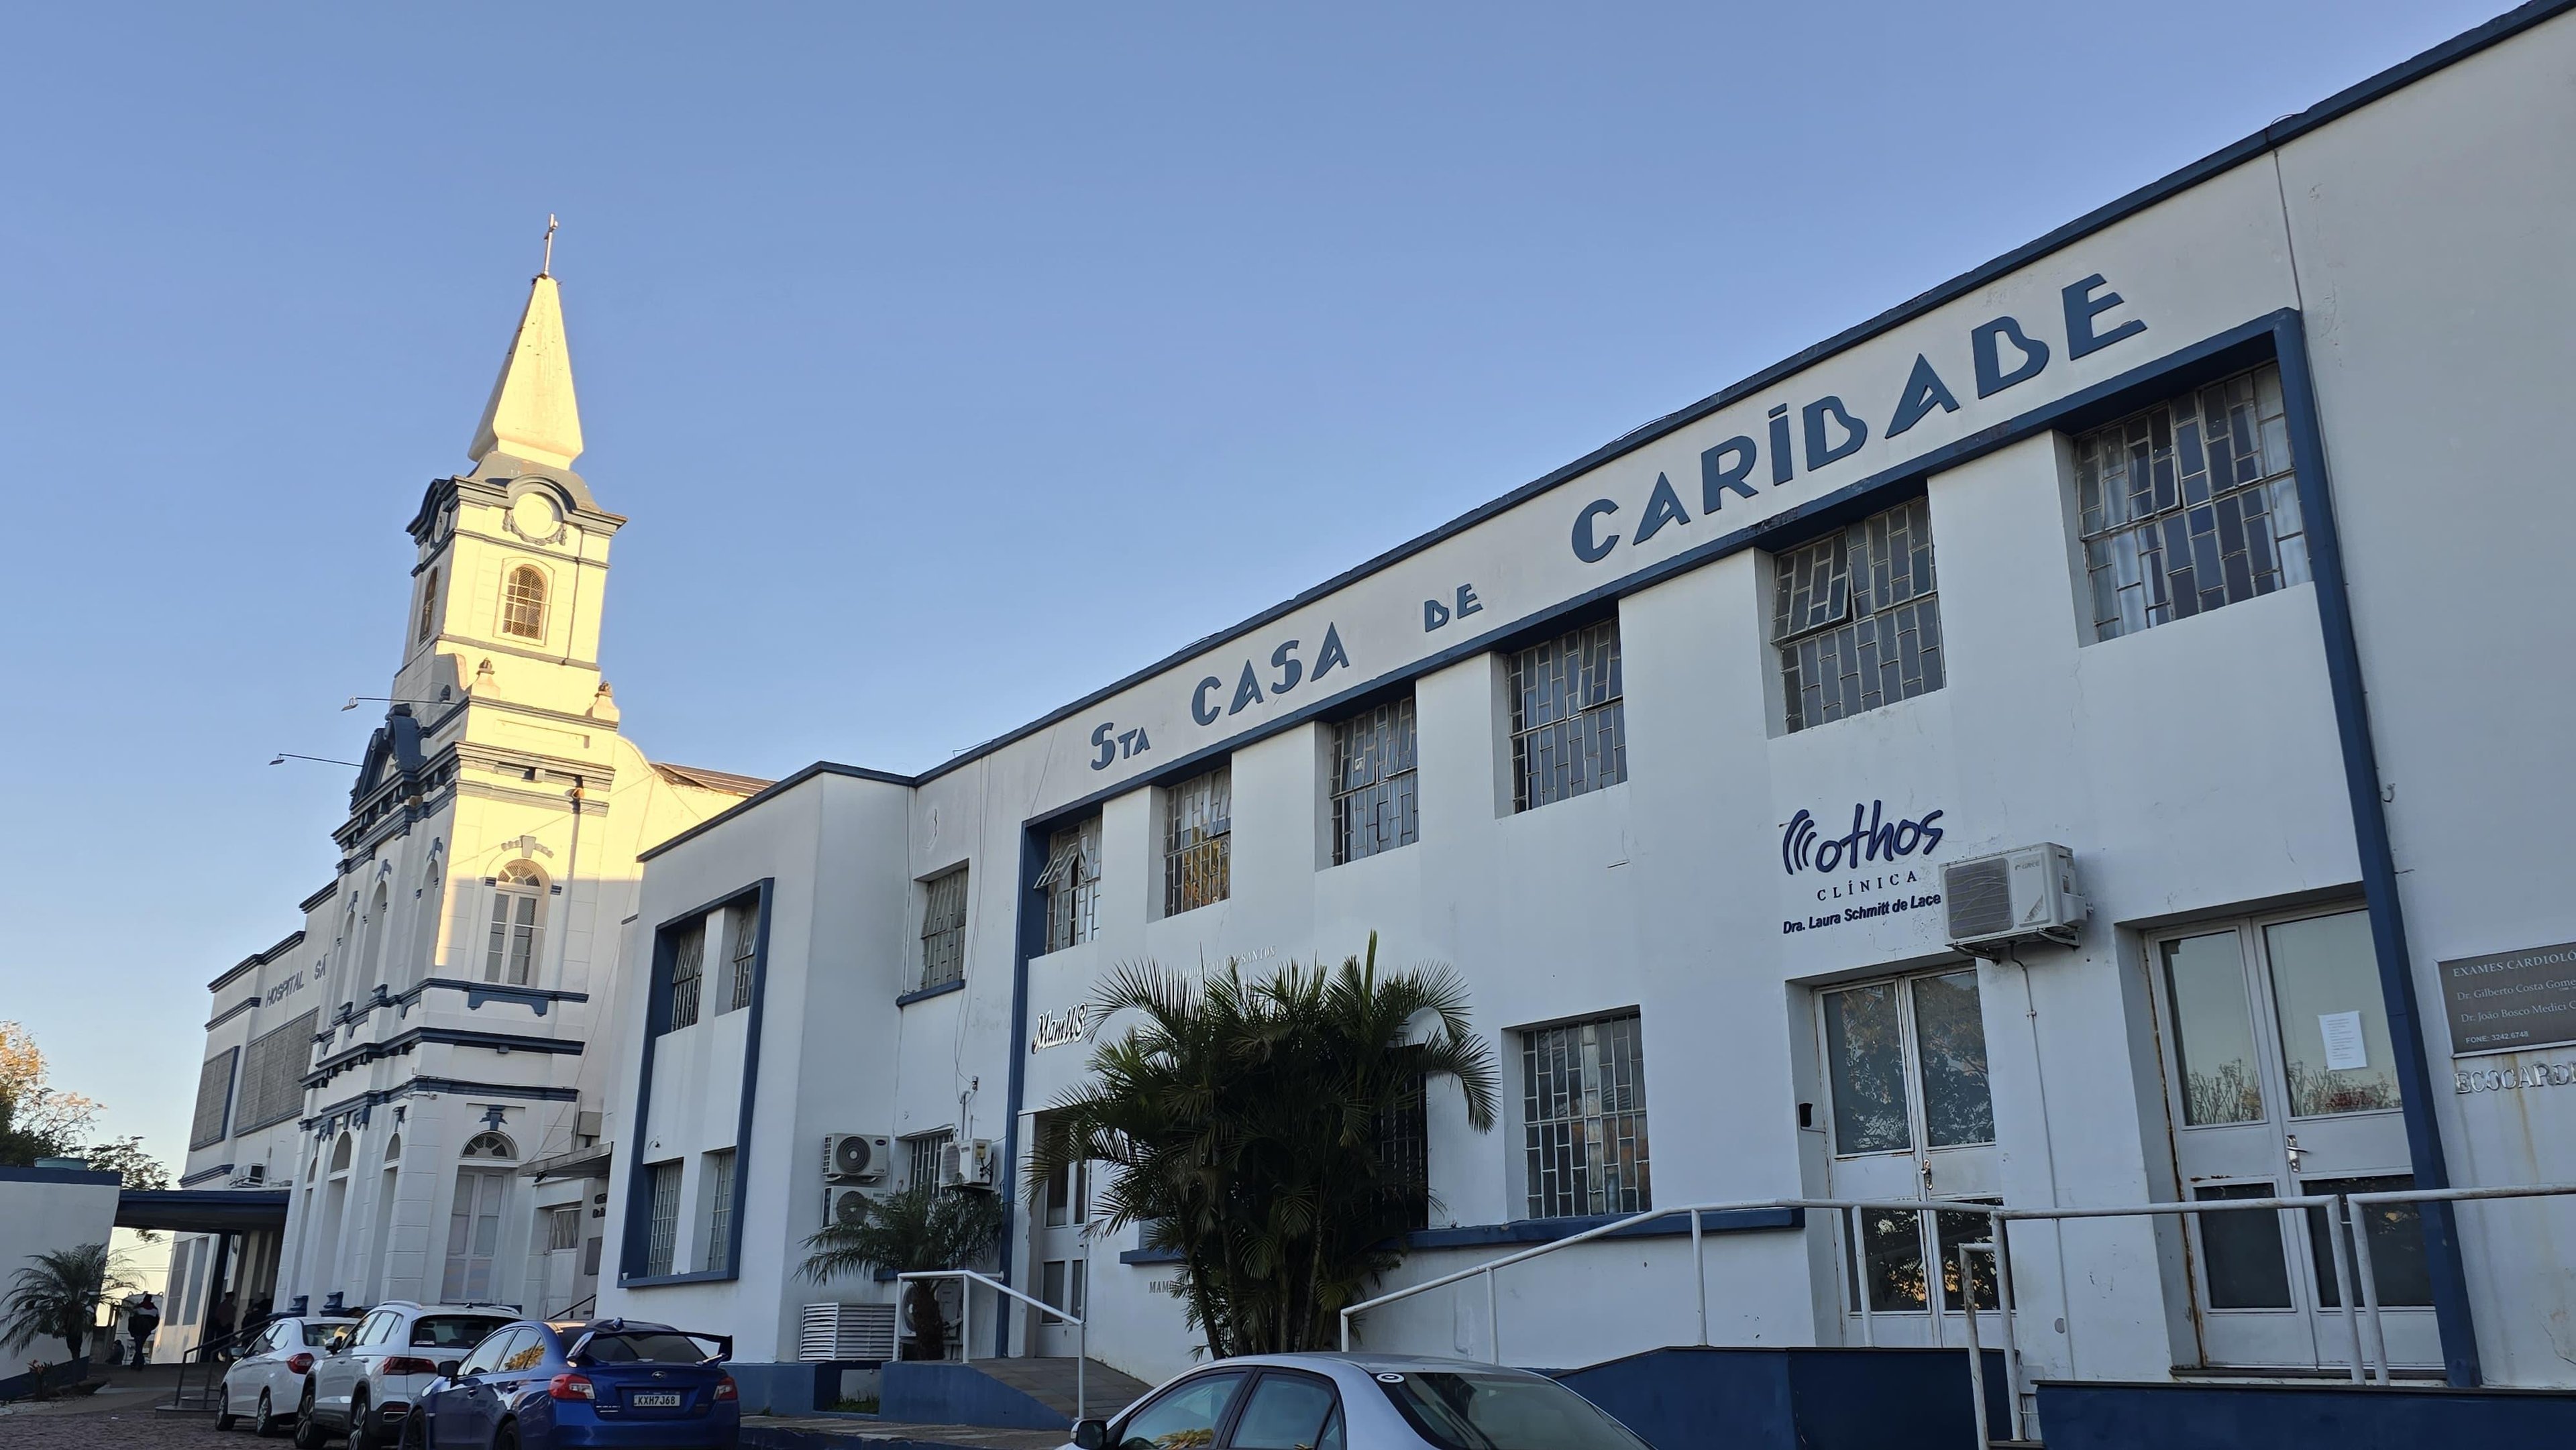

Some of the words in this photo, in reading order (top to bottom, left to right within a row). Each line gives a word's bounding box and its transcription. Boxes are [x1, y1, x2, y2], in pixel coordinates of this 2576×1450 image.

[1191, 621, 1349, 726] CASA
[1424, 583, 1483, 632] DE
[1817, 871, 1917, 901] CLÍNICA
[1782, 921, 1806, 934] Dra.
[1809, 913, 1841, 930] Laura
[1844, 901, 1890, 922] Schmitt
[1892, 899, 1908, 913] de
[1911, 894, 1941, 909] Lace
[2453, 962, 2504, 977] EXAMES
[265, 970, 305, 1008] HOSPITAL
[2457, 991, 2471, 1001] Dr.
[2473, 987, 2514, 999] Gilberto
[2516, 983, 2544, 993] Costa
[2461, 1014, 2475, 1023] Dr.
[2501, 1008, 2530, 1018] Bosco
[2532, 1002, 2567, 1013] Medici
[2465, 1036, 2489, 1044] FONE:
